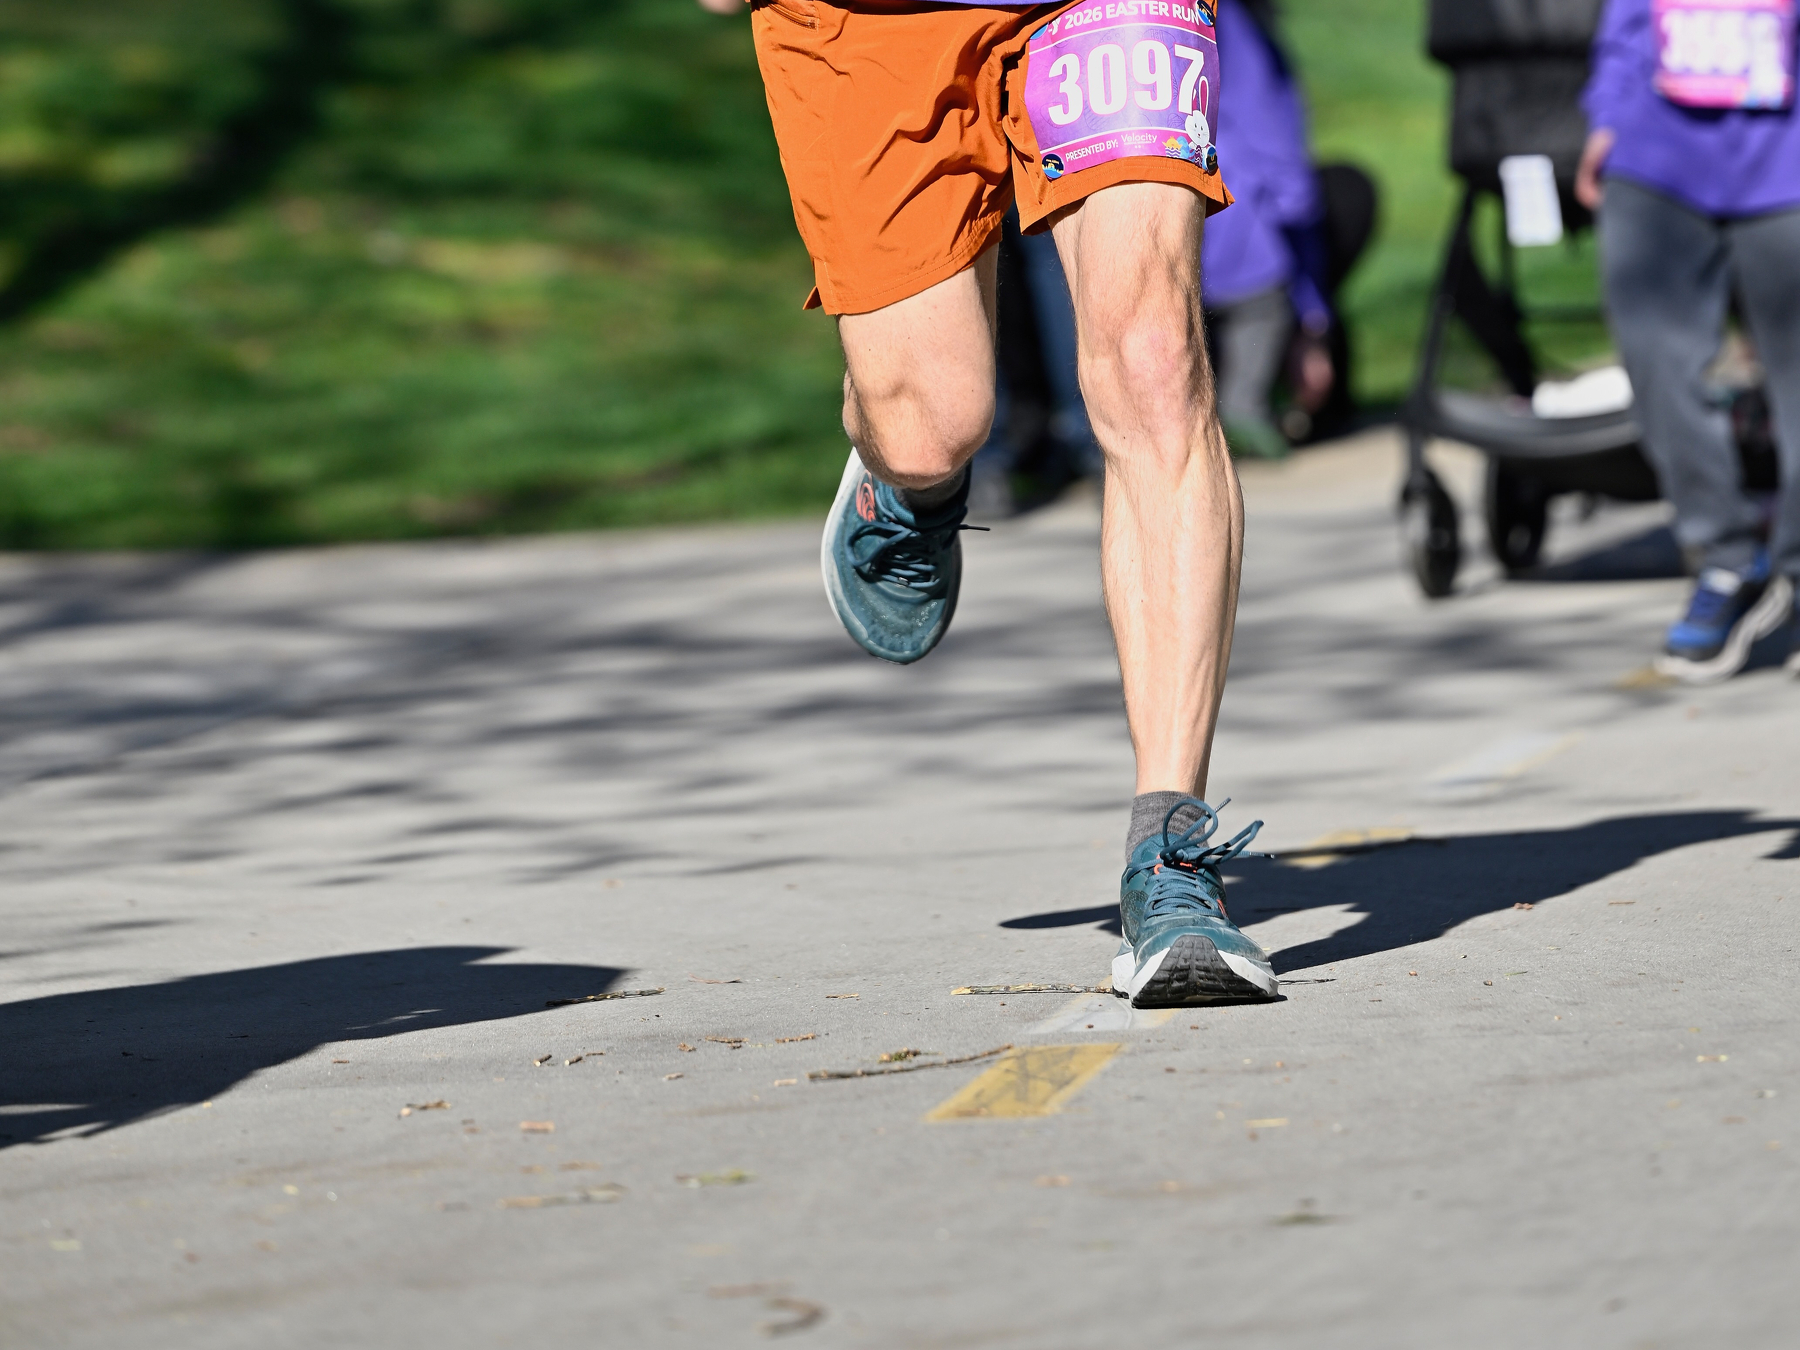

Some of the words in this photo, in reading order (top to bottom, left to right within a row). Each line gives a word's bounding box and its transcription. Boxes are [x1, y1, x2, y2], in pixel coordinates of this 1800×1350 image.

[1064, 7, 1103, 30] 2026
[1106, 0, 1170, 21] EASTER
[1173, 5, 1200, 26] RUN
[1048, 40, 1205, 125] 3097
[1065, 143, 1105, 162] PRESENTED
[1106, 139, 1119, 150] BY:
[1121, 132, 1158, 143] Velocity
